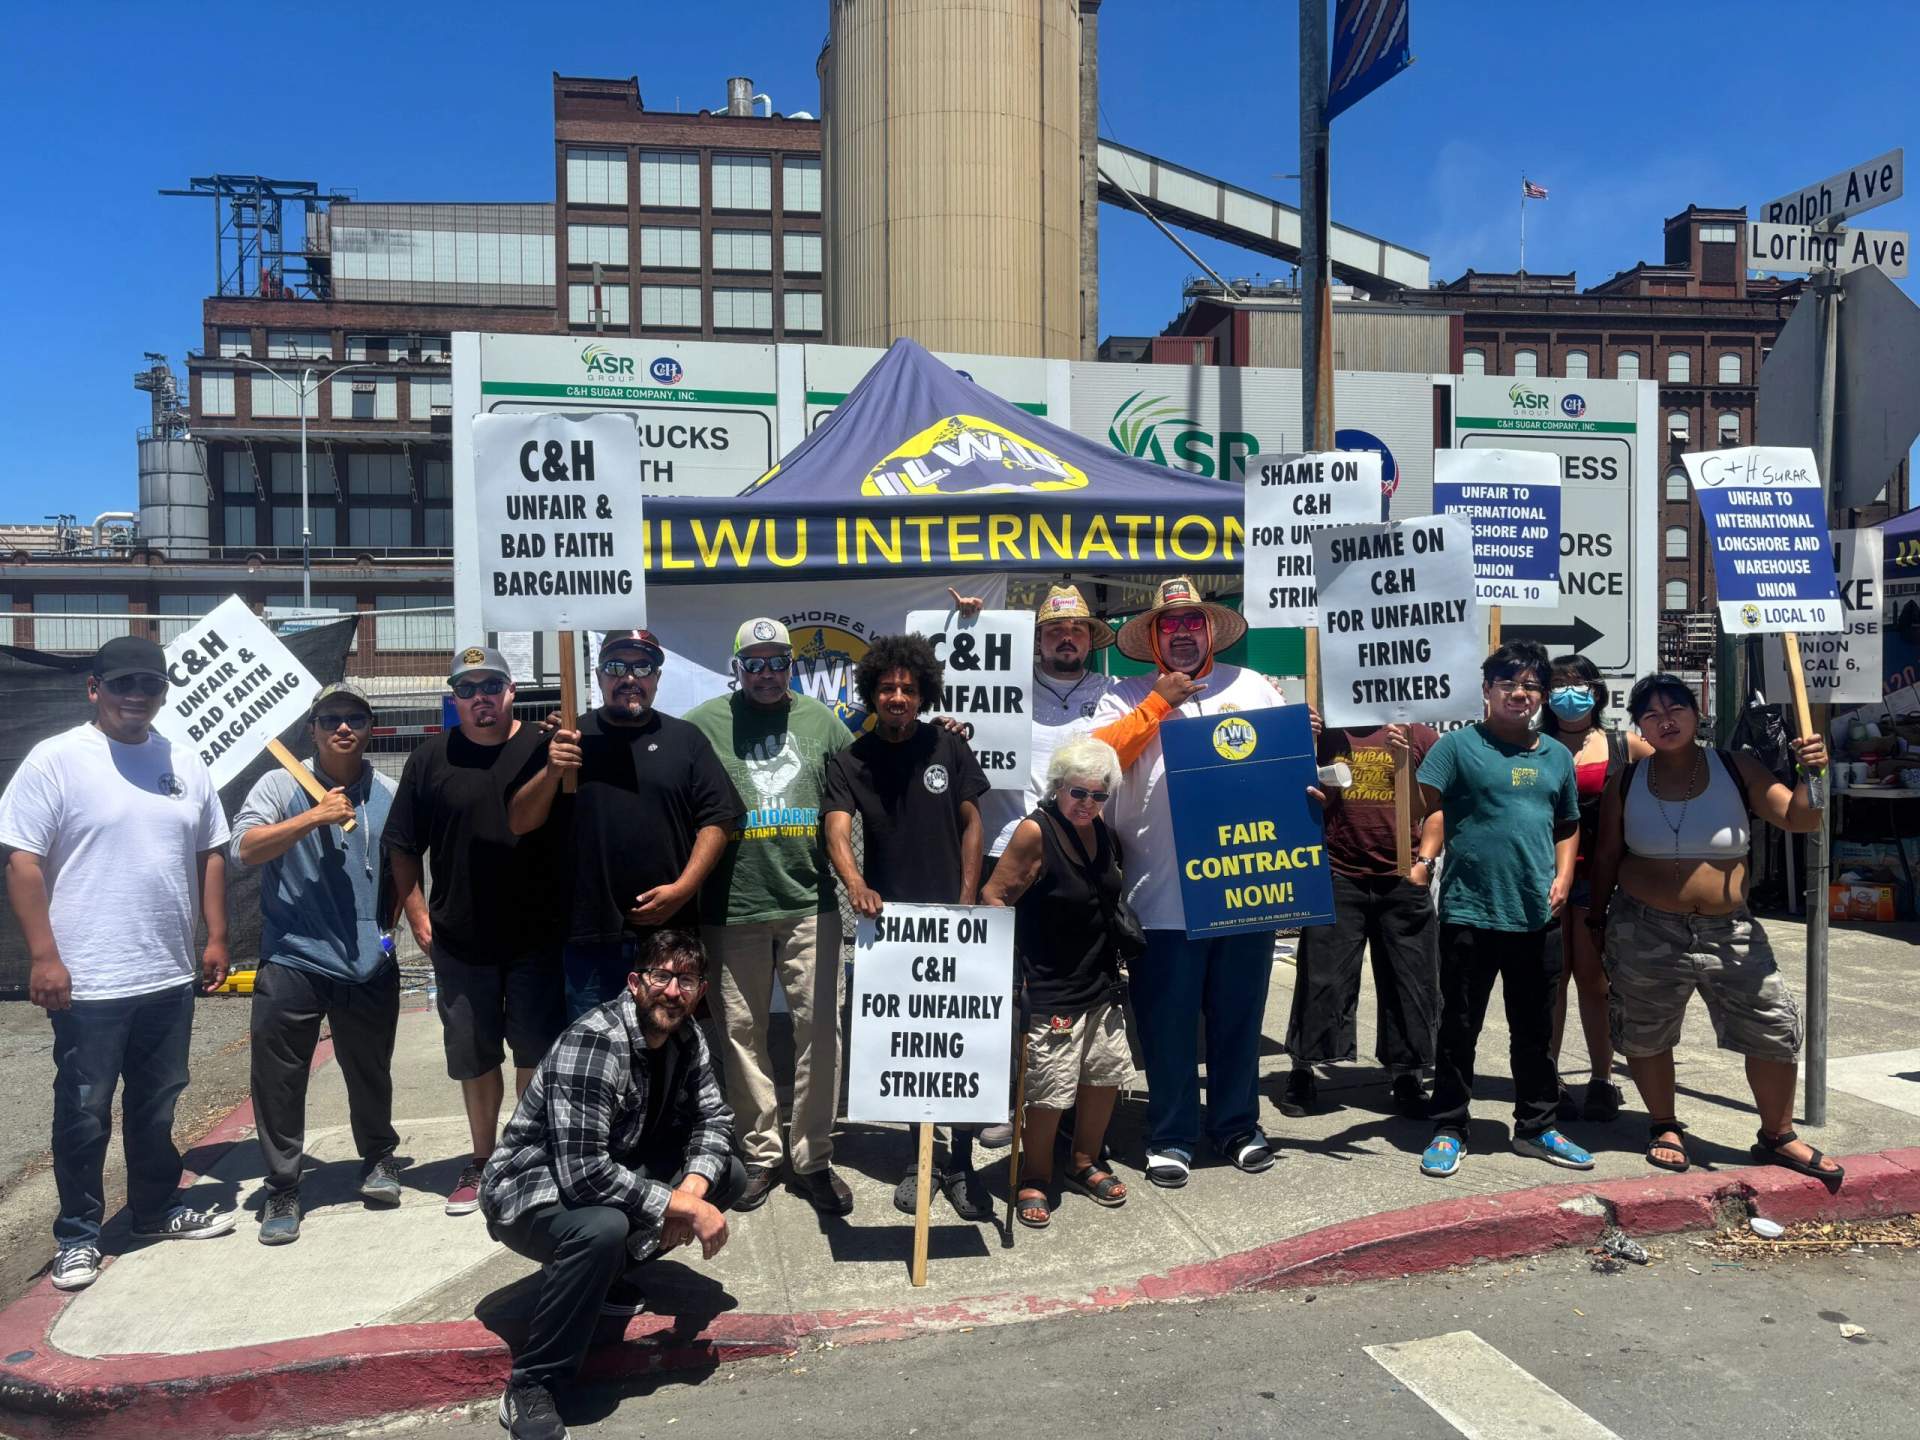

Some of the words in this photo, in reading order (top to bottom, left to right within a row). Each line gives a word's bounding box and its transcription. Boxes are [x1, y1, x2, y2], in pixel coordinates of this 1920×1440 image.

[1769, 184, 1832, 226] Rolph
[1845, 164, 1893, 207] Ave
[1753, 224, 1837, 268] Loring
[1852, 231, 1905, 267] Ave
[586, 354, 634, 375] ASR
[587, 374, 635, 382] GROUP
[566, 386, 588, 397] C&H
[590, 387, 623, 398] SUGAR
[626, 388, 676, 401] COMPANY,
[678, 391, 698, 401] INC.
[1513, 392, 1549, 410] ASR
[639, 424, 730, 451] UCKS
[1497, 420, 1514, 429] C&H
[1515, 421, 1541, 429] SUGAR
[1582, 423, 1598, 431] INC.
[520, 440, 595, 482] C&H
[873, 428, 1077, 496] ILWU
[1133, 422, 1260, 482] ASR
[1261, 462, 1324, 486] SHAME
[1331, 461, 1358, 482] ON
[1293, 493, 1331, 515] C&H
[1461, 486, 1509, 500] UNFAIR
[1513, 487, 1530, 501] TO
[1728, 491, 1773, 505] UNFAIR
[1775, 491, 1793, 506] TO
[506, 495, 586, 521] UNFAIR
[595, 494, 612, 520] &
[1716, 513, 1815, 528] INTERNATIONAL
[501, 534, 545, 558] BAD
[554, 532, 613, 557] FAITH
[643, 518, 807, 569] ILWU
[836, 513, 1244, 564] INTERNATION
[1252, 526, 1284, 546] FOR
[1521, 526, 1549, 539] AND
[1717, 536, 1791, 551] LONGSHORE
[1794, 536, 1820, 551] AND
[1331, 532, 1404, 564] SHAME
[1412, 528, 1444, 553] ON
[1473, 544, 1534, 558] REHOUSE
[1277, 555, 1316, 576] FIRI
[1474, 563, 1514, 577] UNION
[1734, 559, 1811, 574] WAREHOUSE
[493, 570, 632, 597] BARGAINING
[1371, 568, 1416, 596] C&H
[1476, 585, 1519, 599] LOCAL
[1523, 586, 1540, 600] 10
[1756, 582, 1797, 597] UNION
[1269, 587, 1318, 609] STRIK
[779, 610, 850, 627] SHORE
[852, 621, 865, 634] &
[1327, 608, 1364, 634] FOR
[1371, 599, 1467, 630] UNFAIRLY
[1765, 608, 1807, 623] LOCAL
[1809, 608, 1825, 623] 10
[168, 629, 229, 688] C&H
[928, 632, 1012, 671] C&H
[1358, 639, 1431, 667] FIRING
[1799, 640, 1849, 654] NION
[1783, 658, 1839, 672] LCAL
[175, 661, 239, 718] UNFAIR
[238, 647, 256, 664] &
[1352, 674, 1451, 704] STRIKERS
[187, 705, 224, 743] BAD
[222, 663, 273, 709] FAITH
[934, 685, 1024, 713] NFAIR
[200, 672, 300, 767] BARGAINING
[1218, 820, 1277, 846] FAIR
[1185, 845, 1323, 881] CONTRACT
[1224, 881, 1294, 909] NOW!
[875, 916, 949, 942] SHAME
[957, 918, 987, 943] ON
[912, 956, 956, 982] C&H
[862, 993, 900, 1018] FOR
[908, 994, 1003, 1019] UNFAIRLY
[891, 1031, 964, 1058] FIRING
[880, 1070, 979, 1098] STRIKERS
